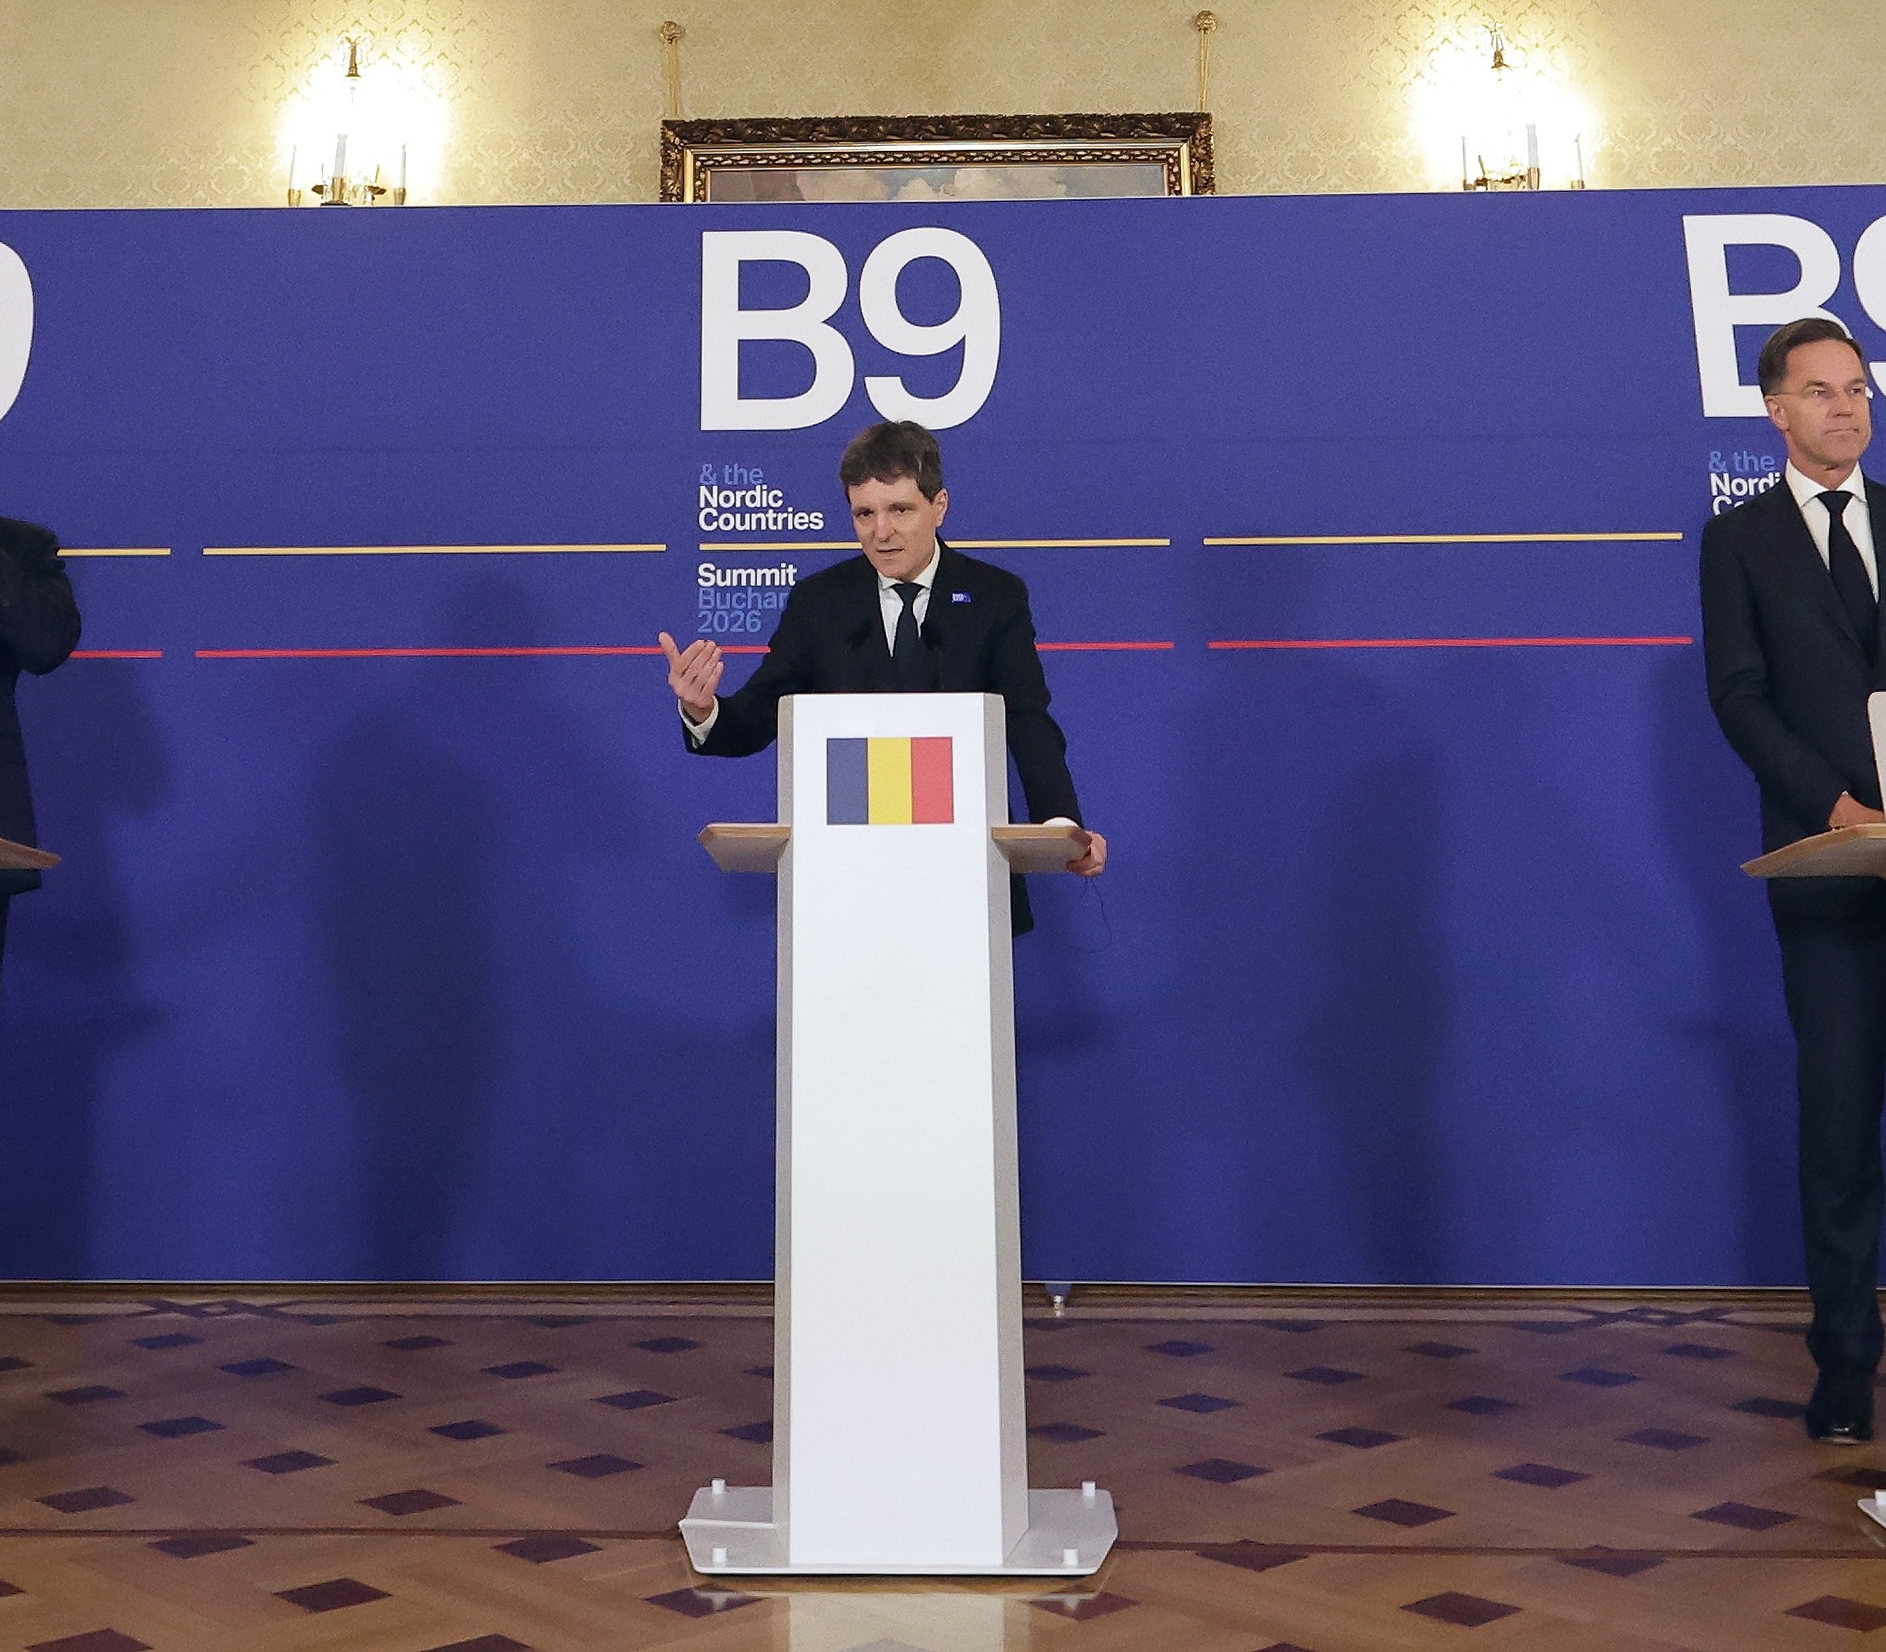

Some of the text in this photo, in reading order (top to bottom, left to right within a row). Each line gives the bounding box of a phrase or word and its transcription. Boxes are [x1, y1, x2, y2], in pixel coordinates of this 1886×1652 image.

[700, 227, 1001, 431] B9
[1709, 450, 1775, 472] & the
[699, 463, 764, 485] & the
[699, 484, 784, 508] Nordic
[698, 507, 825, 531] Countries
[697, 563, 797, 587] Summit
[697, 610, 762, 633] 2026
